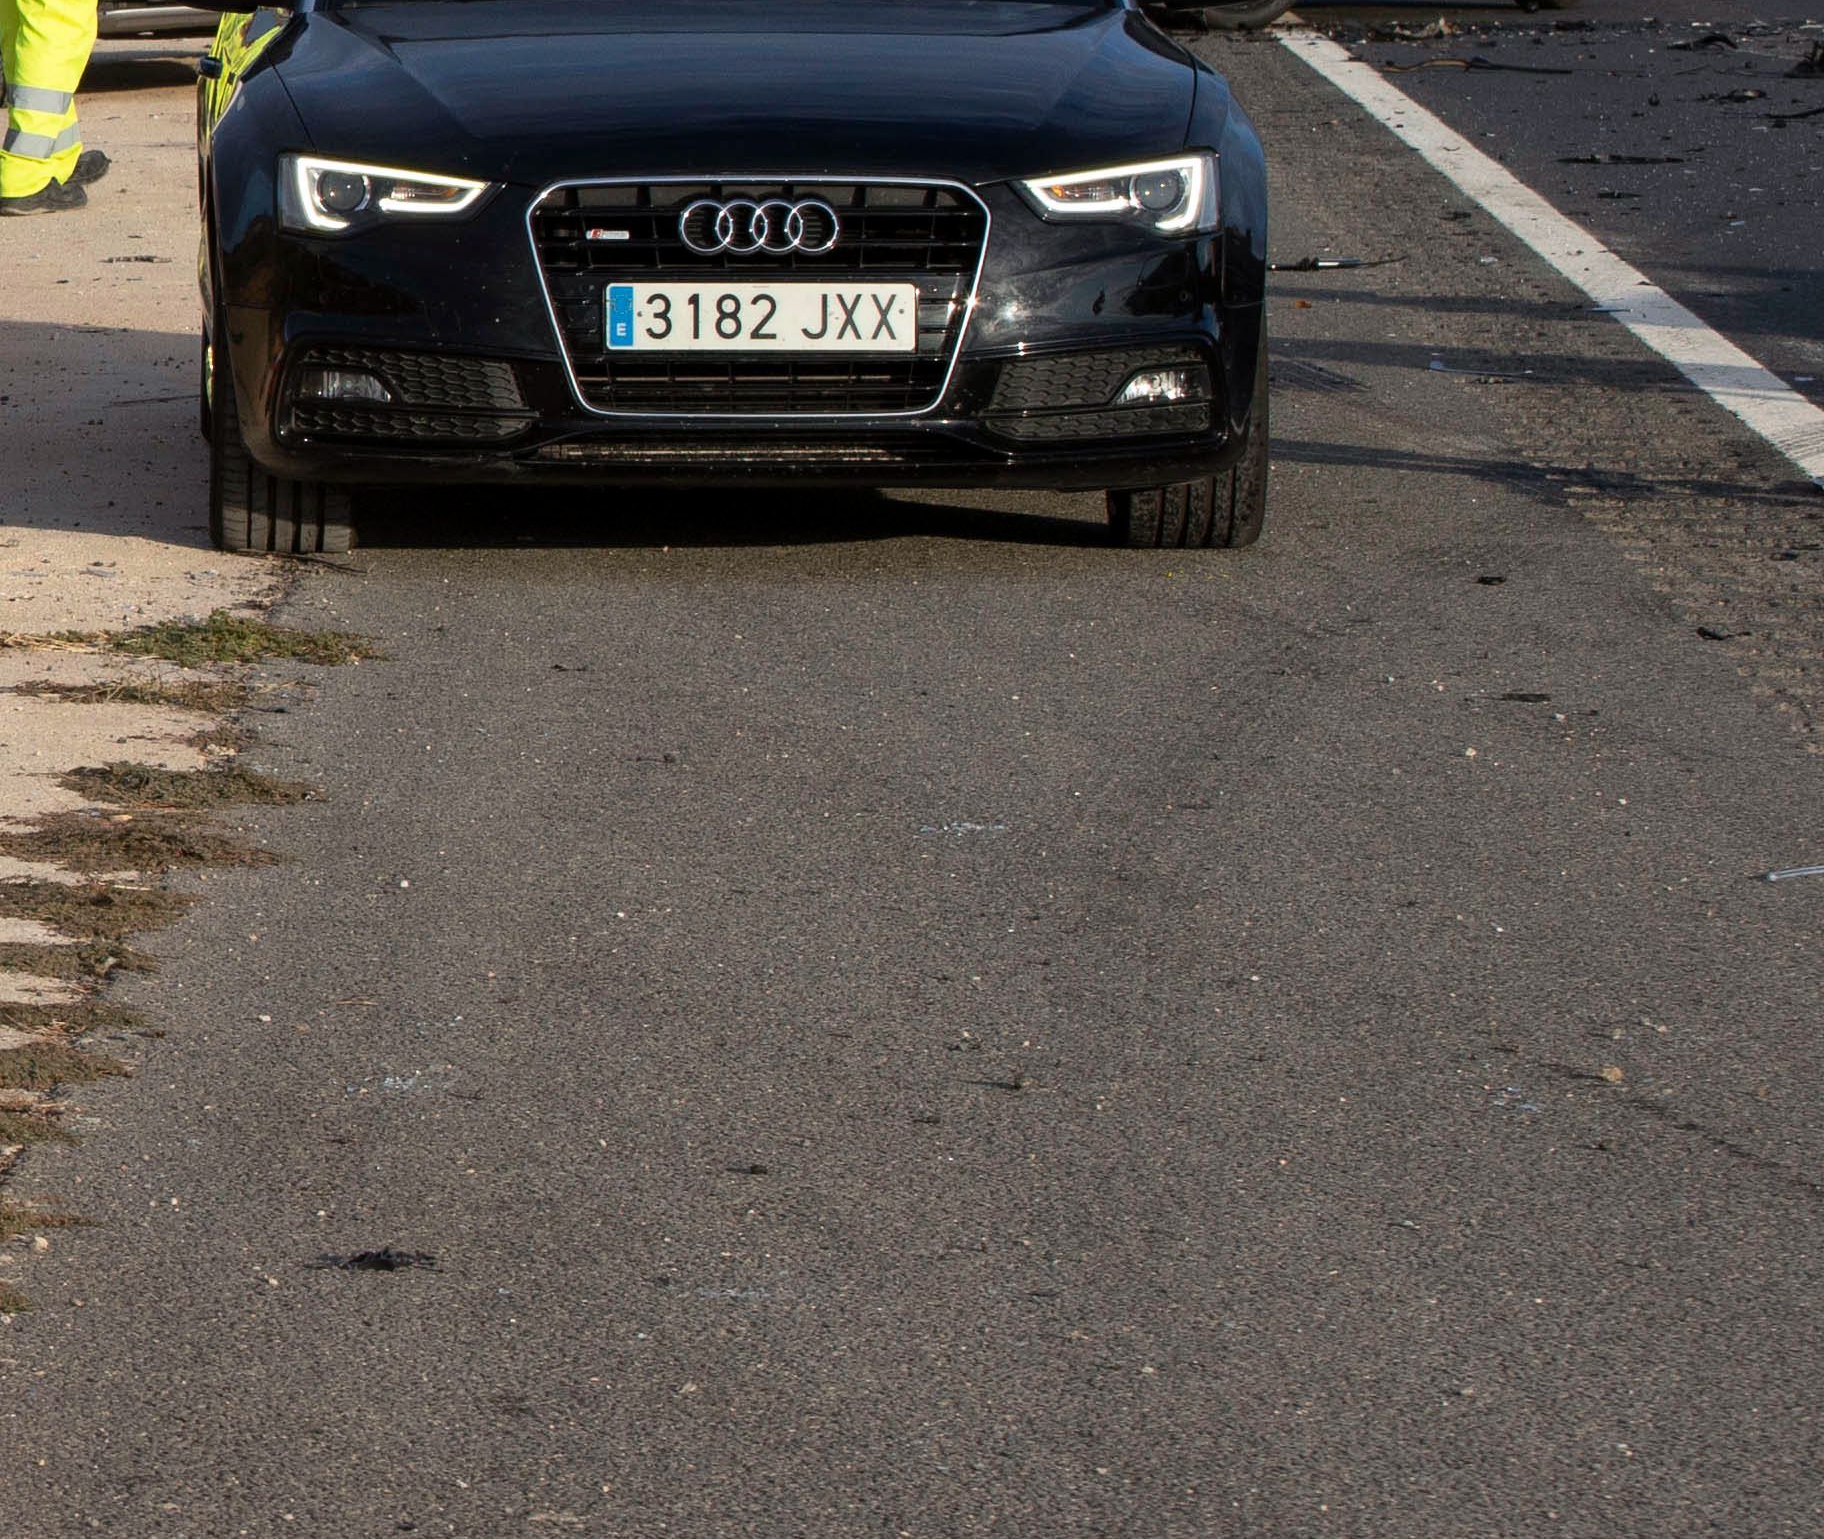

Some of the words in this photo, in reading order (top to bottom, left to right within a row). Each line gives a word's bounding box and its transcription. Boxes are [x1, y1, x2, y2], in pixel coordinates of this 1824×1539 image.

[616, 322, 627, 337] E
[645, 293, 778, 340] 3182
[801, 293, 897, 340] JXX
